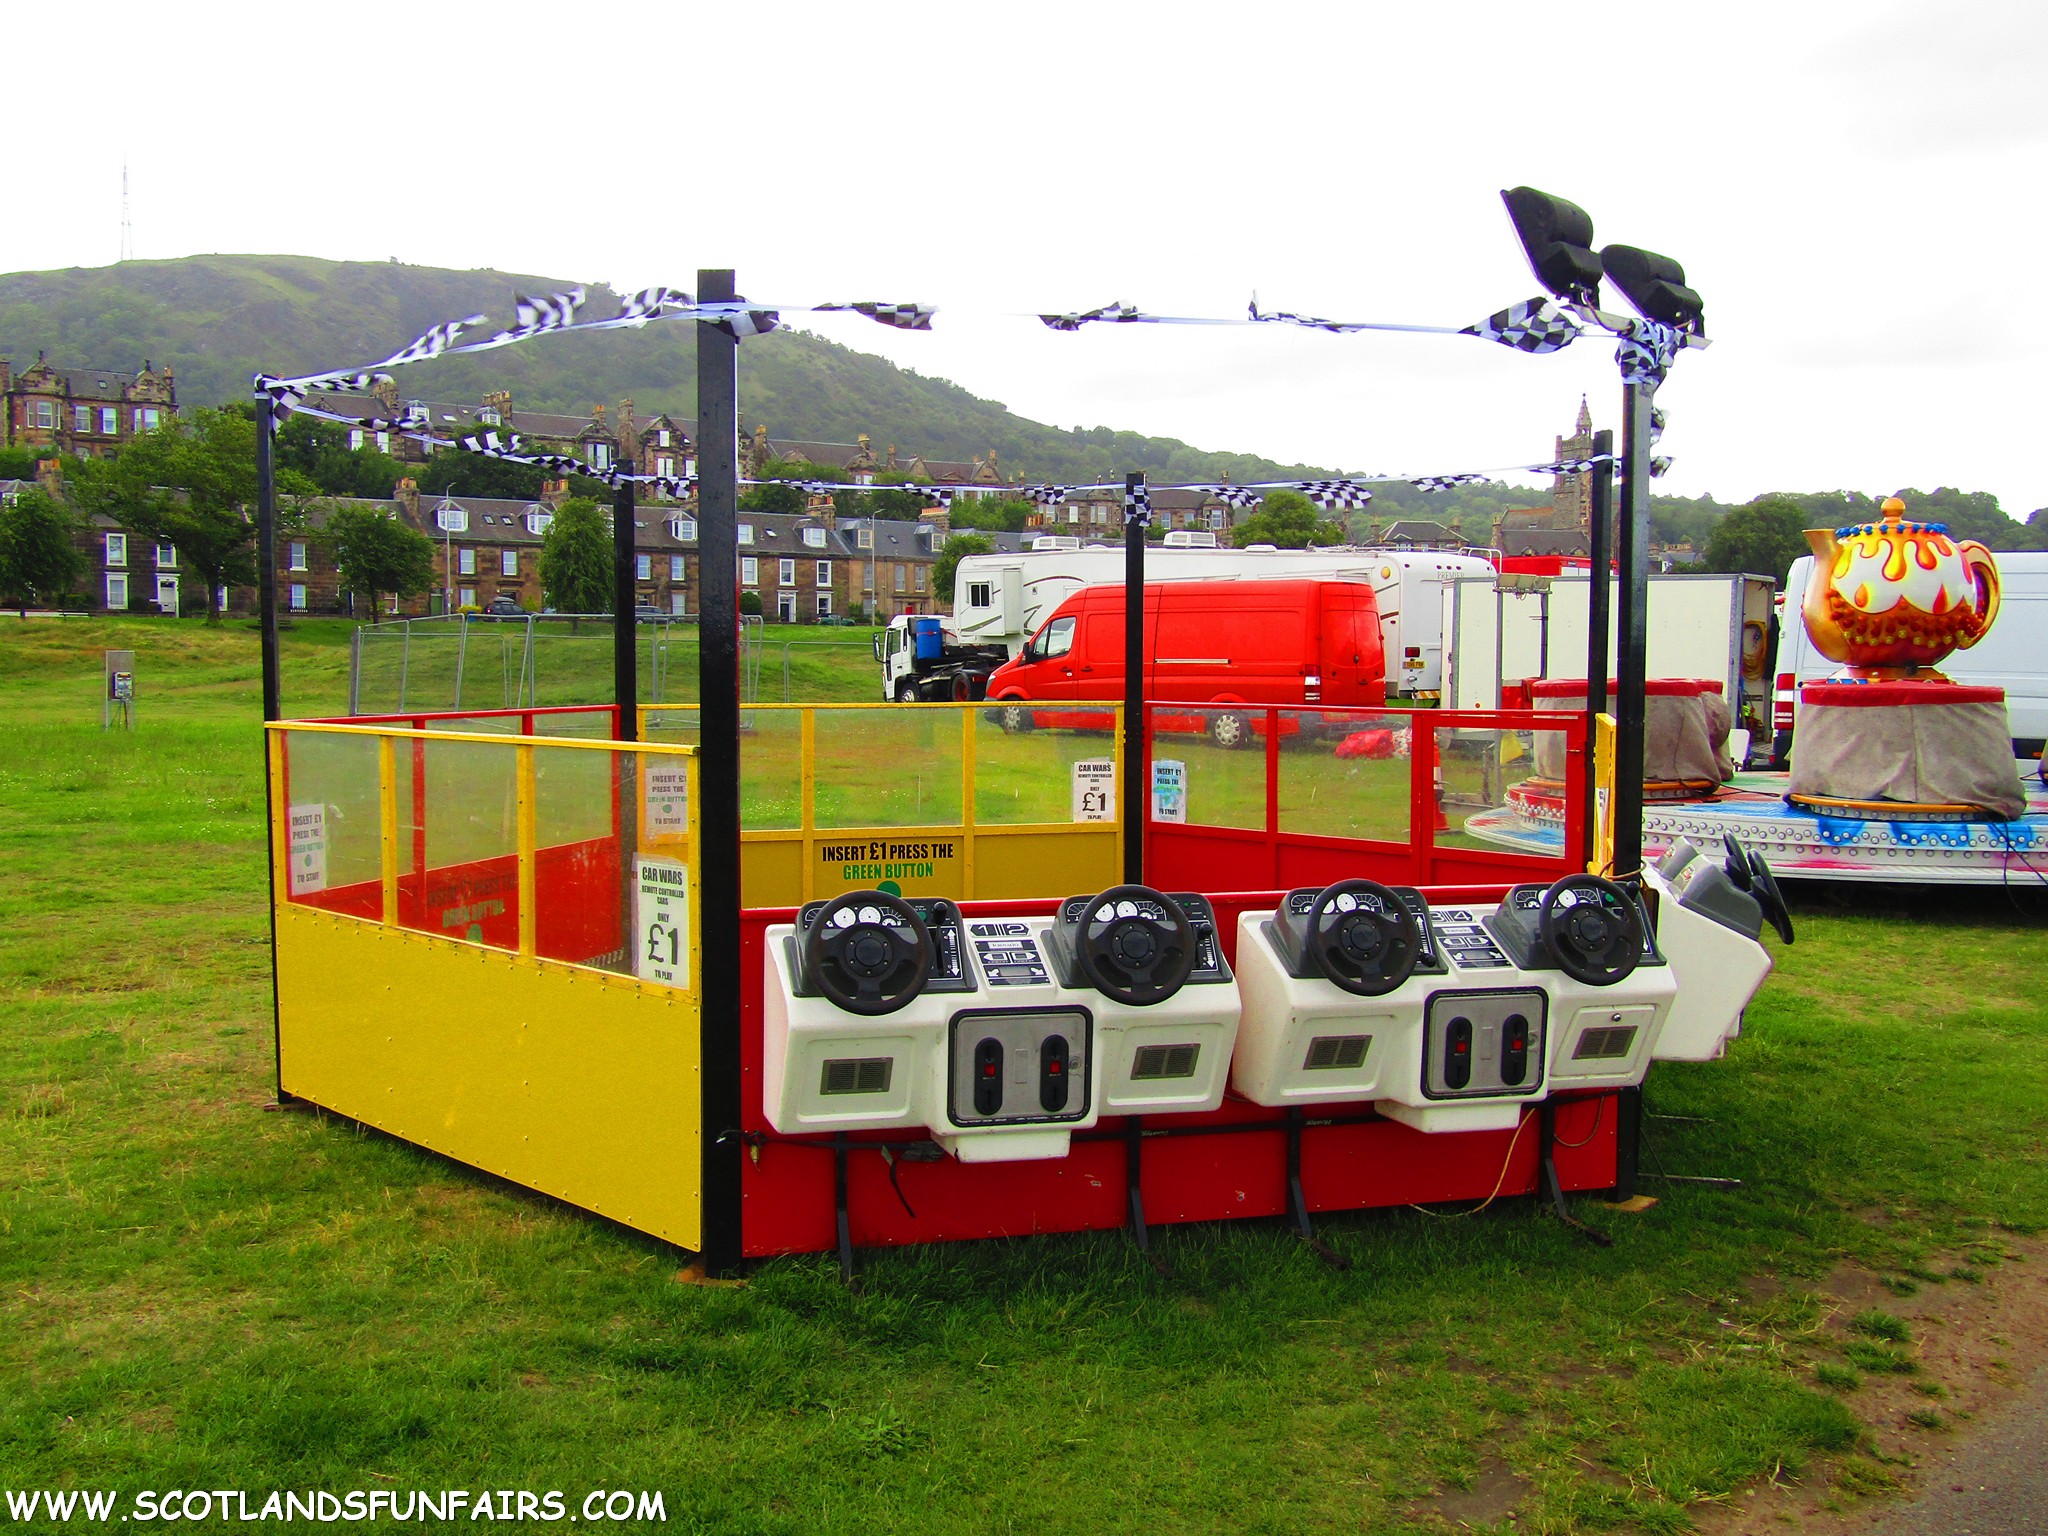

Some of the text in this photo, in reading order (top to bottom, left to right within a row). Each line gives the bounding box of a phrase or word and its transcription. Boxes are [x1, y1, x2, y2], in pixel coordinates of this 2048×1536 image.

[1078, 764, 1112, 772] CAR WARS
[652, 774, 676, 783] INSERT
[1082, 792, 1106, 812] £1
[292, 813, 322, 827] INSERT £1
[292, 830, 309, 840] PRESS
[822, 842, 954, 861] INSERT £1 PRESS THE
[642, 866, 683, 886] CAR WARS
[843, 862, 933, 880] GREEN BUTTON
[297, 874, 305, 883] TO
[641, 885, 684, 898] REMOTE CONTROLLED
[657, 896, 669, 905] CARS
[657, 912, 670, 923] ONLY
[1430, 911, 1472, 922] 3 4
[978, 924, 1027, 936] 1 2
[647, 923, 679, 966] £1
[655, 969, 673, 980] TO PLAY
